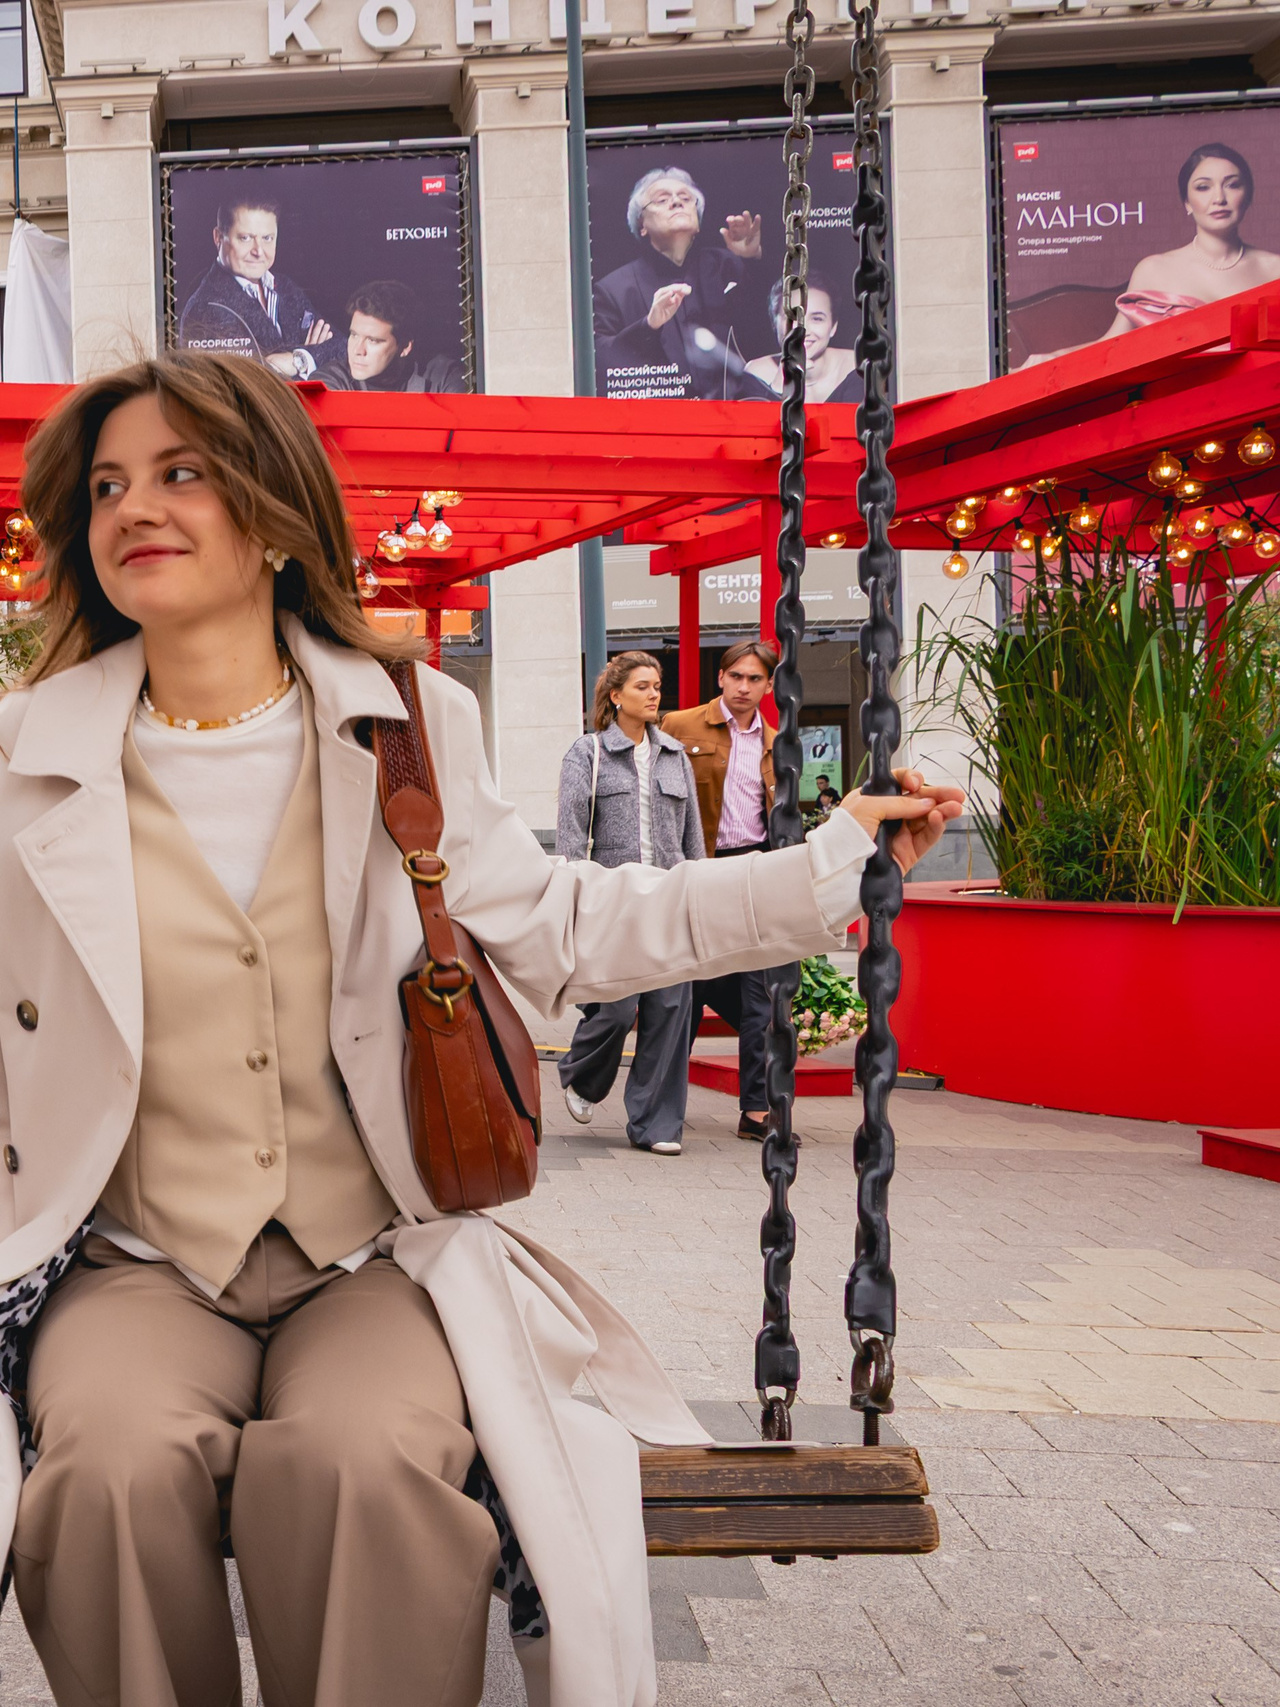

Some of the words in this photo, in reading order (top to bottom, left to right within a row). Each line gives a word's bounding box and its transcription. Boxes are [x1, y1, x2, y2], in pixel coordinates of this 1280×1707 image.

[1016, 191, 1061, 202] МАССНЕ
[1016, 201, 1143, 231] МАНОН
[385, 226, 448, 241] БЕТХОВЕН
[1017, 236, 1046, 246] Опера
[1052, 234, 1102, 245] концертном
[1018, 247, 1068, 256] исполнении
[188, 337, 252, 349] ГОСОРКЕСТР
[607, 363, 679, 377] РОССИЙСКИЙ
[607, 374, 691, 388] НАЦИОНАЛЬНЫЙ
[607, 385, 685, 400] МОЛОДЁЖНЫЙ
[704, 573, 762, 589] СЕНТЯ
[717, 589, 761, 605] 19:00
[846, 585, 862, 600] 12
[611, 598, 657, 607] meloman.ru
